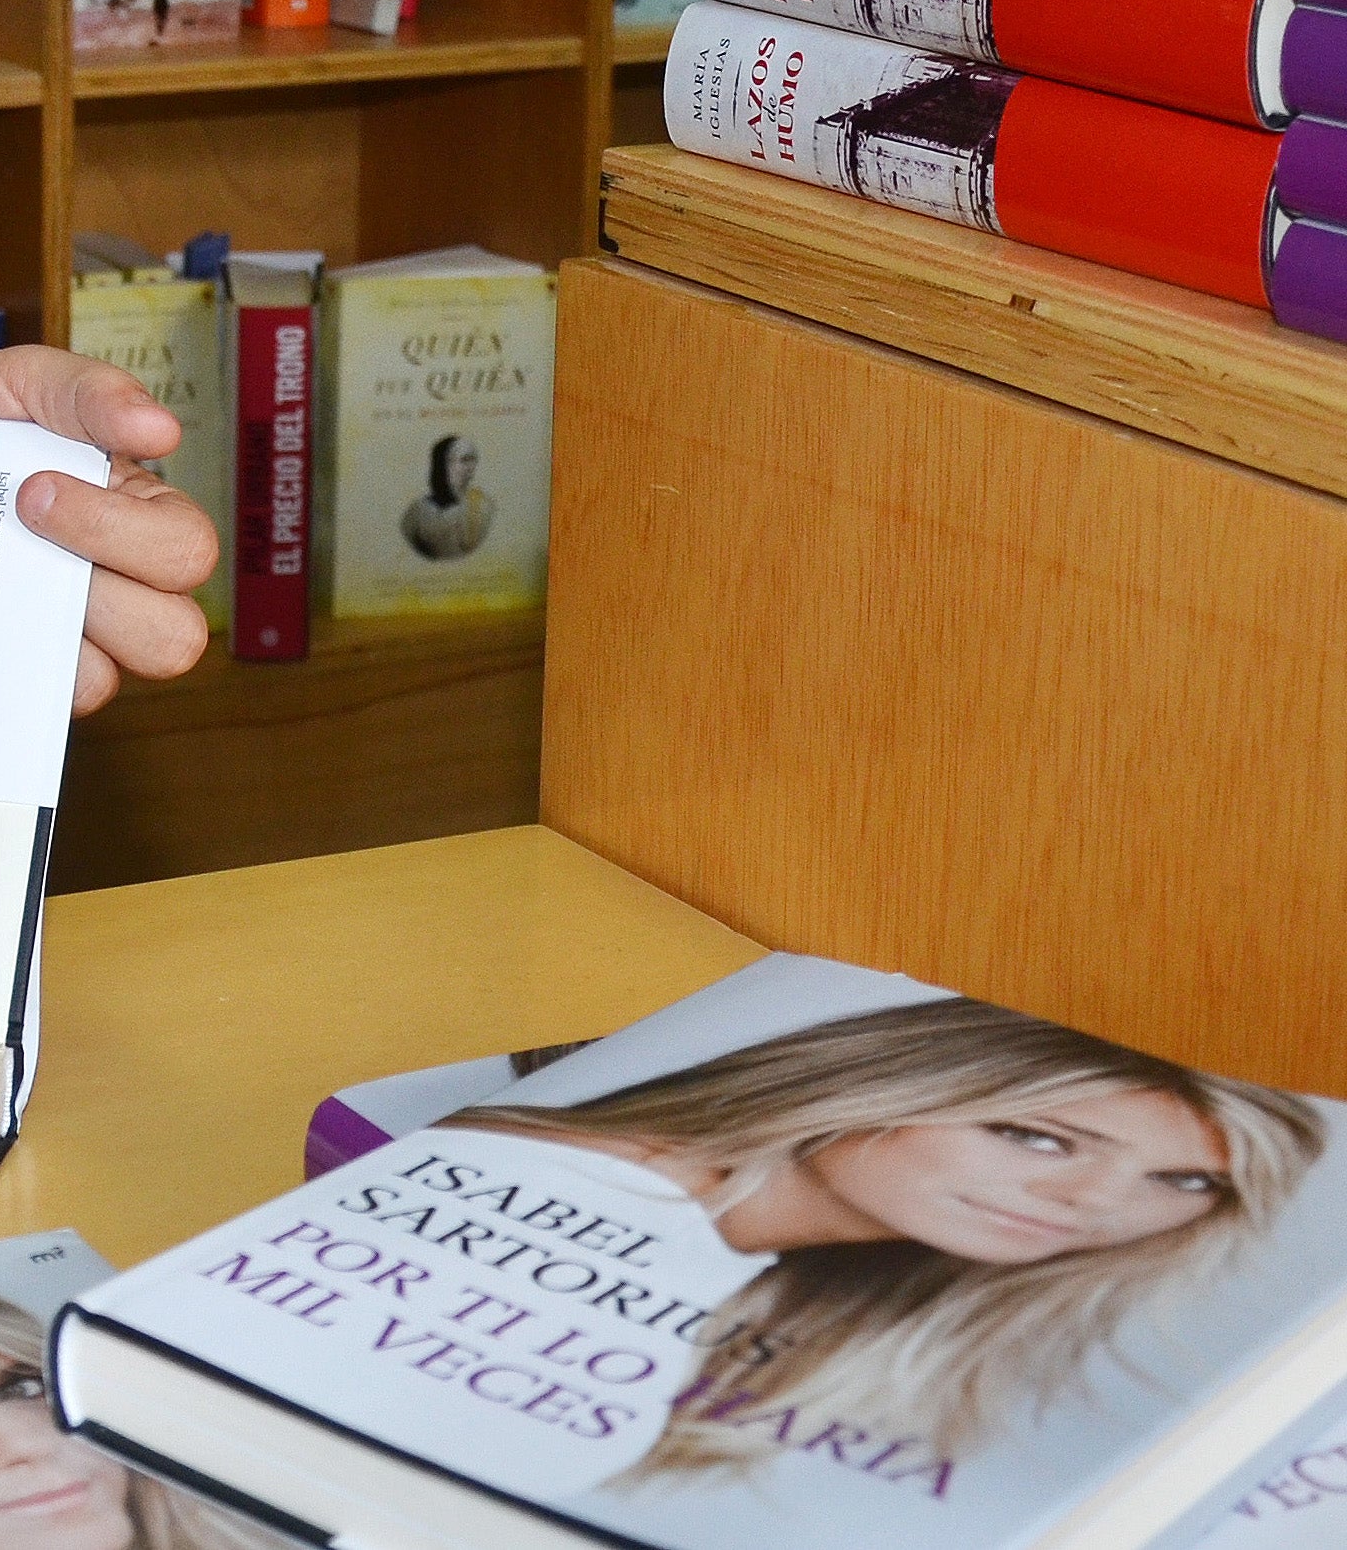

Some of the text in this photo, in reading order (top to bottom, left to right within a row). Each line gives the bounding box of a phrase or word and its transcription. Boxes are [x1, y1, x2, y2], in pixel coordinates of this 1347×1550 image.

[693, 48, 711, 123] MARÍA
[709, 38, 731, 140] IGLESIAS
[747, 37, 777, 161] LAZOS
[762, 92, 778, 123] de
[777, 51, 805, 163] HUMO
[400, 327, 504, 367] QUIÉN
[424, 365, 532, 401] QUIÉN
[269, 325, 306, 575] EL PRECIO DEL TRONO
[394, 1153, 668, 1269] ISABEL
[268, 1220, 431, 1298] POR
[447, 1286, 533, 1339] TI
[540, 1325, 657, 1386] LO
[337, 1182, 795, 1368] SARTORIUS
[200, 1249, 640, 1441] MIL VECES
